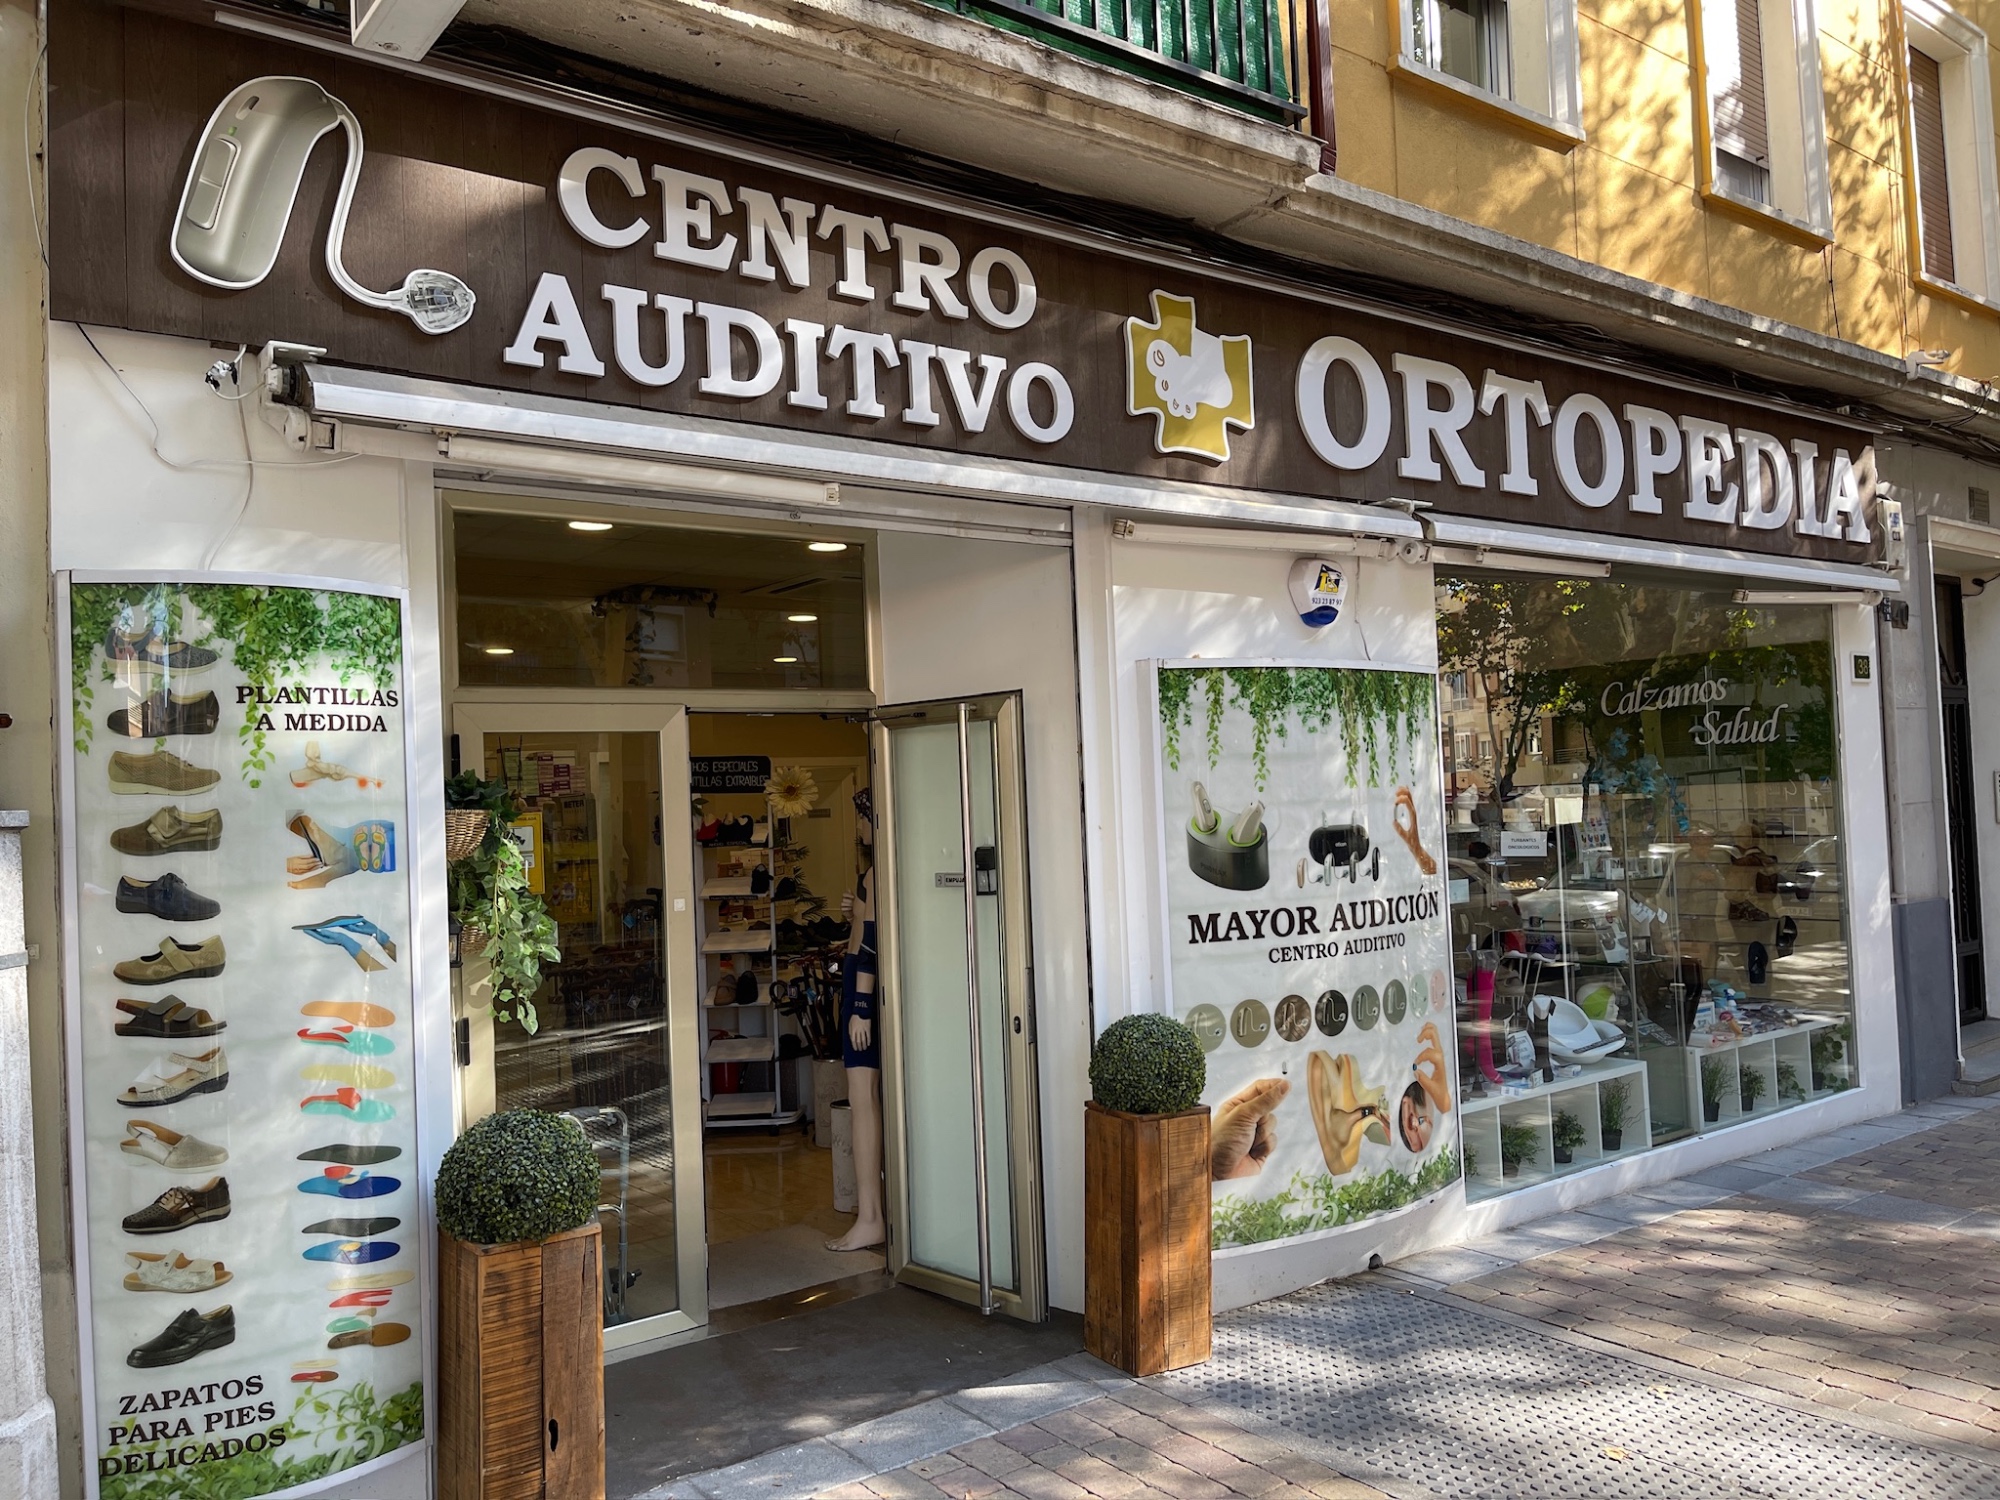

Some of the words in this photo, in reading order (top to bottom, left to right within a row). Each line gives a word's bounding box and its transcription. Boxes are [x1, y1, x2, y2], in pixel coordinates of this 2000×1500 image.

[557, 147, 1037, 330] CENTRO
[503, 272, 1076, 444] AUDITIVO
[1295, 335, 1872, 544] ORTOPEDIA
[1857, 658, 1869, 675] 38
[235, 685, 399, 708] PLANTILLAS
[1601, 676, 1728, 717] Calzamos
[254, 713, 276, 731] A
[284, 713, 388, 733] MEDIDA
[1695, 703, 1788, 745] Salud
[713, 760, 758, 772] ESPECIALES
[1188, 906, 1320, 944] MAYOR
[1329, 885, 1439, 933] AUDICIÓN
[1268, 941, 1339, 964] CENTRO
[1343, 932, 1406, 956] AUDITIVO
[119, 1375, 264, 1416] ZAPATOS
[108, 1417, 195, 1446] PARA
[204, 1401, 276, 1433] PIES
[99, 1427, 287, 1477] DELICADOS
